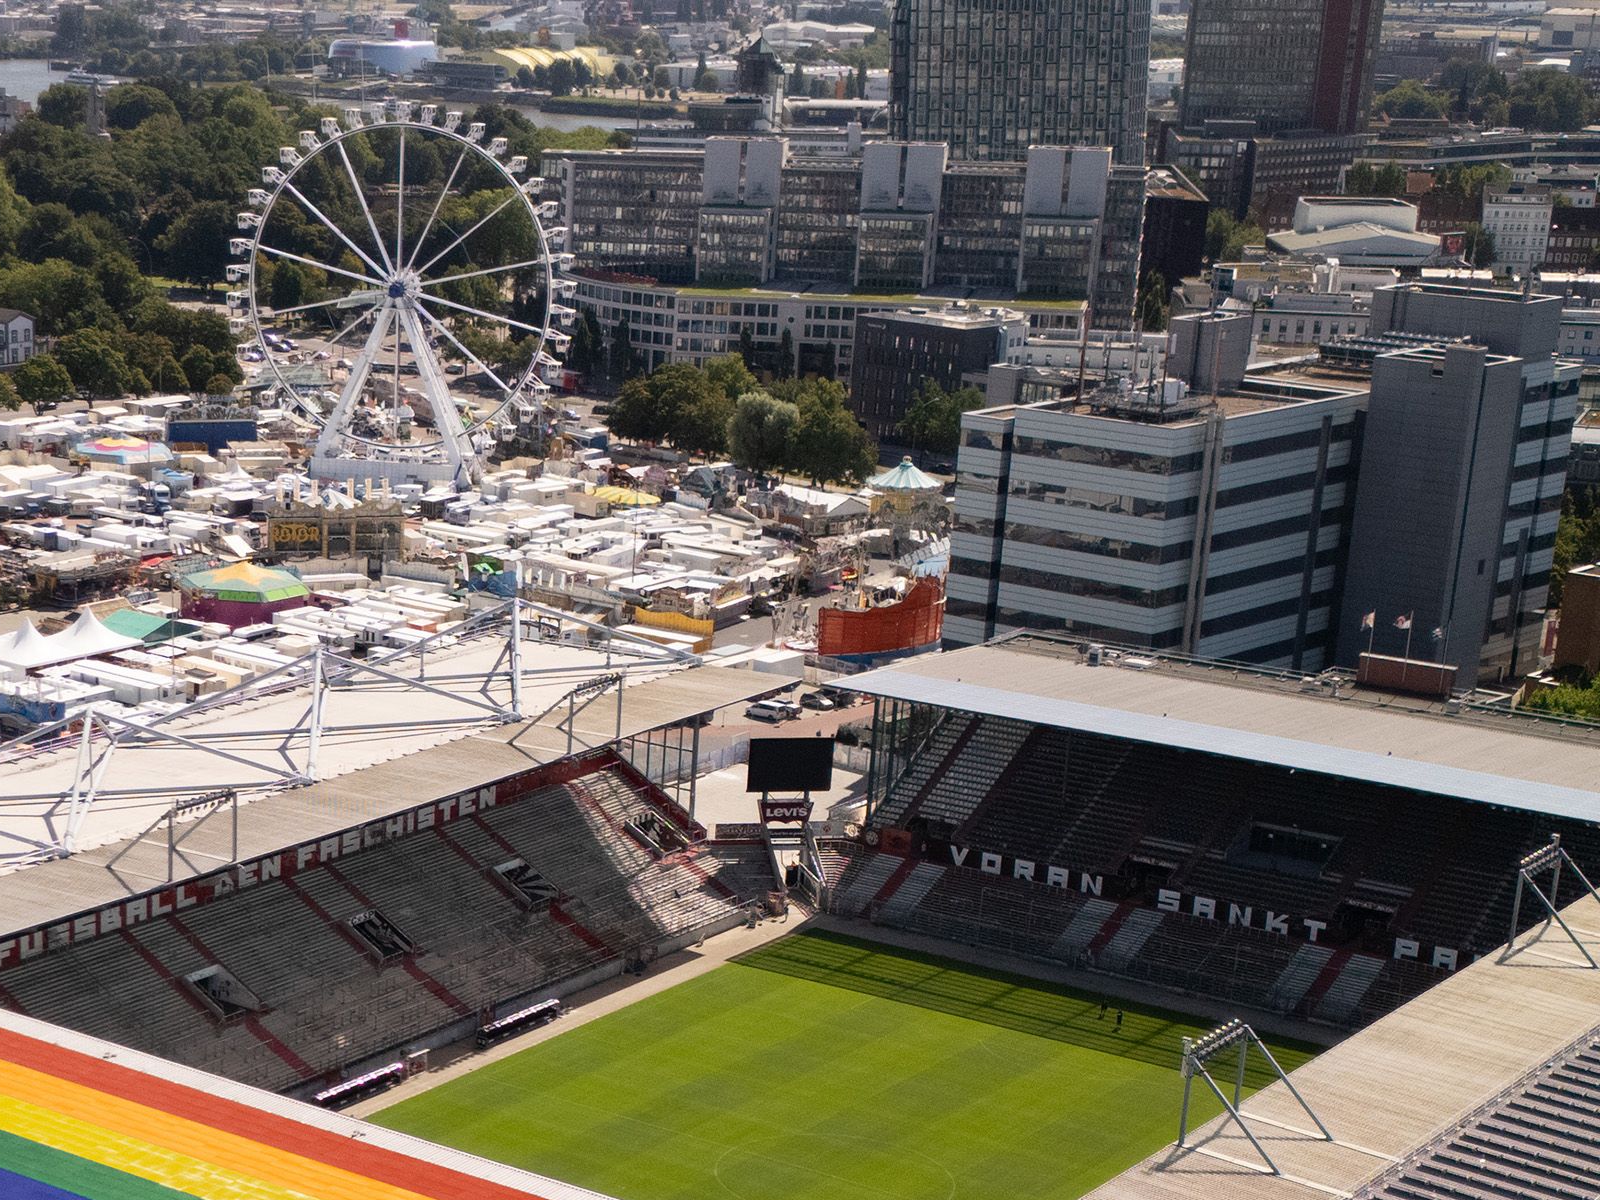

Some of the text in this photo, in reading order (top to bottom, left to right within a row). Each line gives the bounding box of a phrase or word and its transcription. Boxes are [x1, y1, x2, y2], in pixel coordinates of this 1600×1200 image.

[271, 523, 320, 543] ROTOR
[214, 854, 281, 897] DEN
[297, 786, 496, 871] FASCHISTEN
[949, 844, 1482, 972] VORAN SANKT PA
